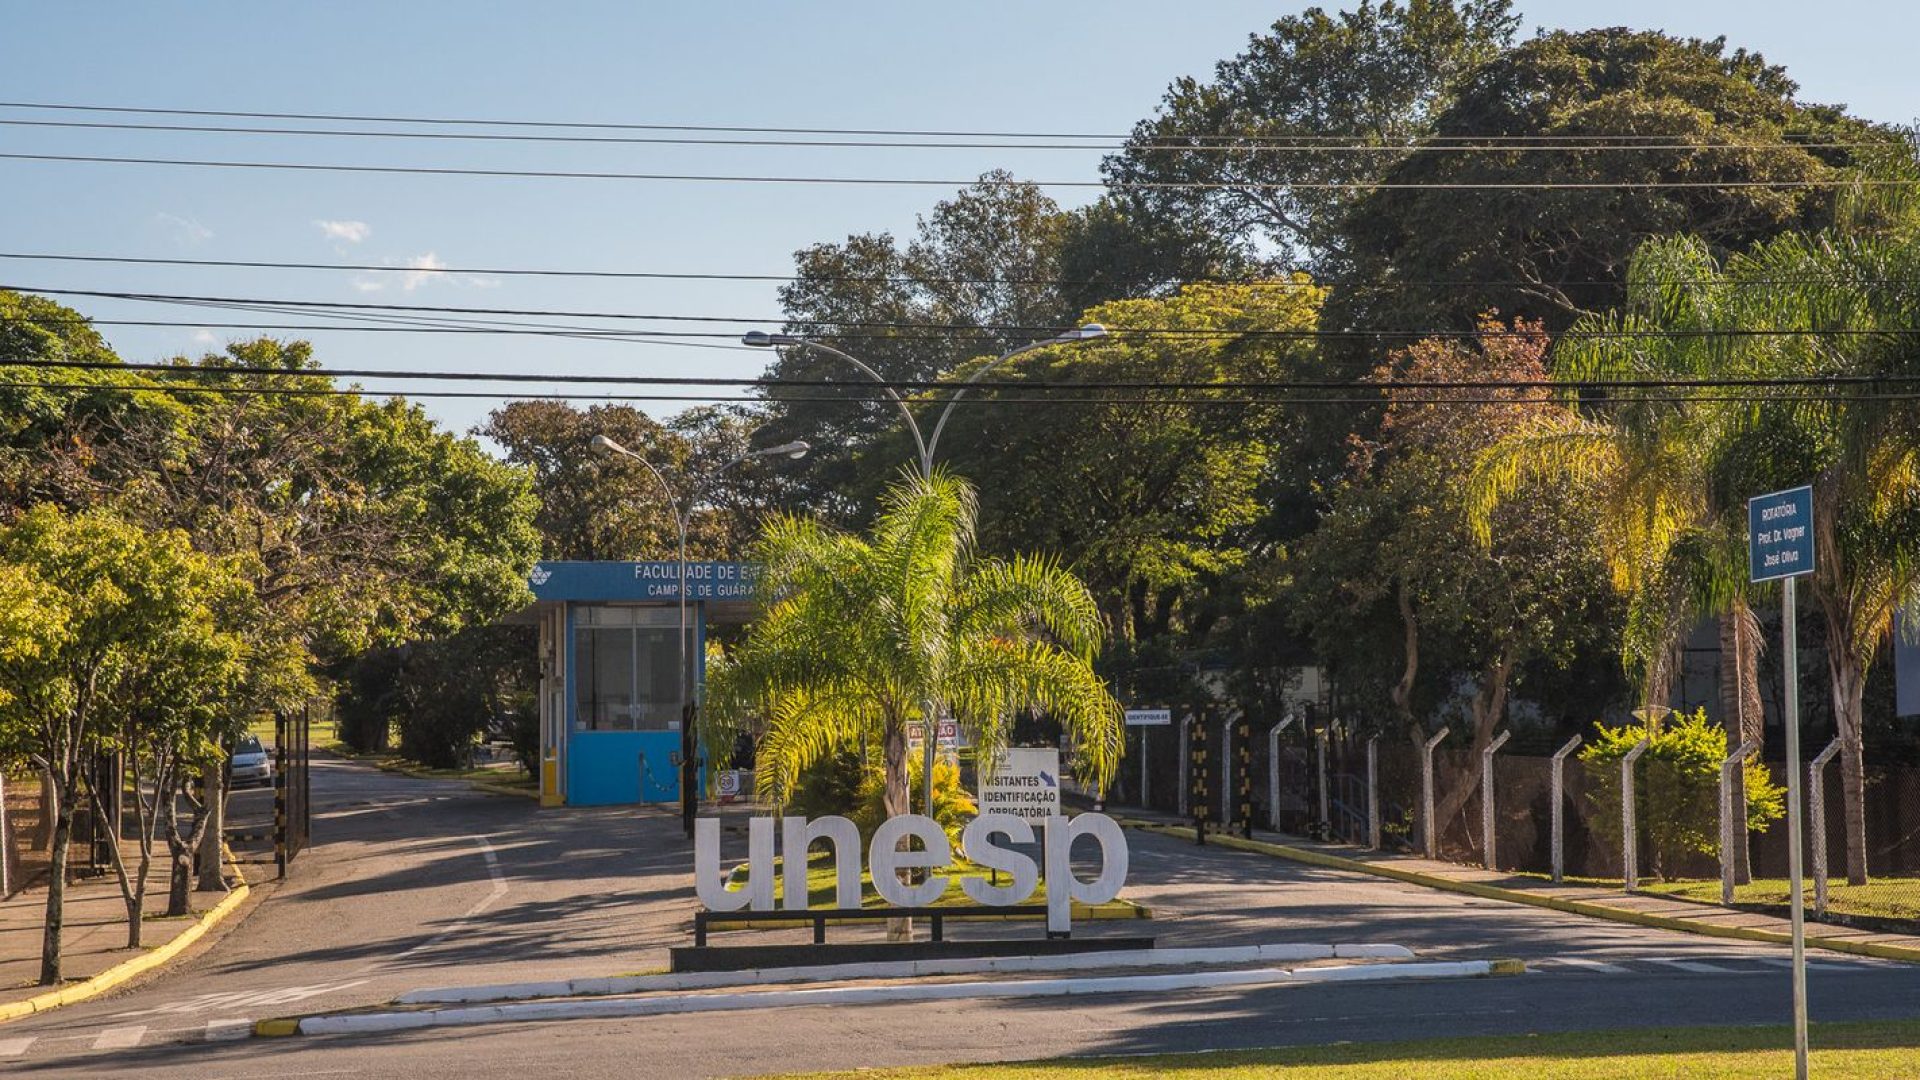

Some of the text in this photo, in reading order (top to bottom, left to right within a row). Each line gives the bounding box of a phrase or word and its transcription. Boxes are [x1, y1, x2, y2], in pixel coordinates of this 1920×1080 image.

[1762, 501, 1797, 521] ROTATÓRIA
[1758, 525, 1805, 545] Prof. Dr. Vagner
[1764, 550, 1799, 567] José Oliva
[717, 565, 734, 579] DE
[648, 584, 692, 596] CAMPS
[698, 585, 712, 596] DE
[984, 776, 1039, 786] VISITANTES
[984, 790, 1056, 805] IDENTIFICAÇÃO
[695, 813, 1129, 933] unesp
